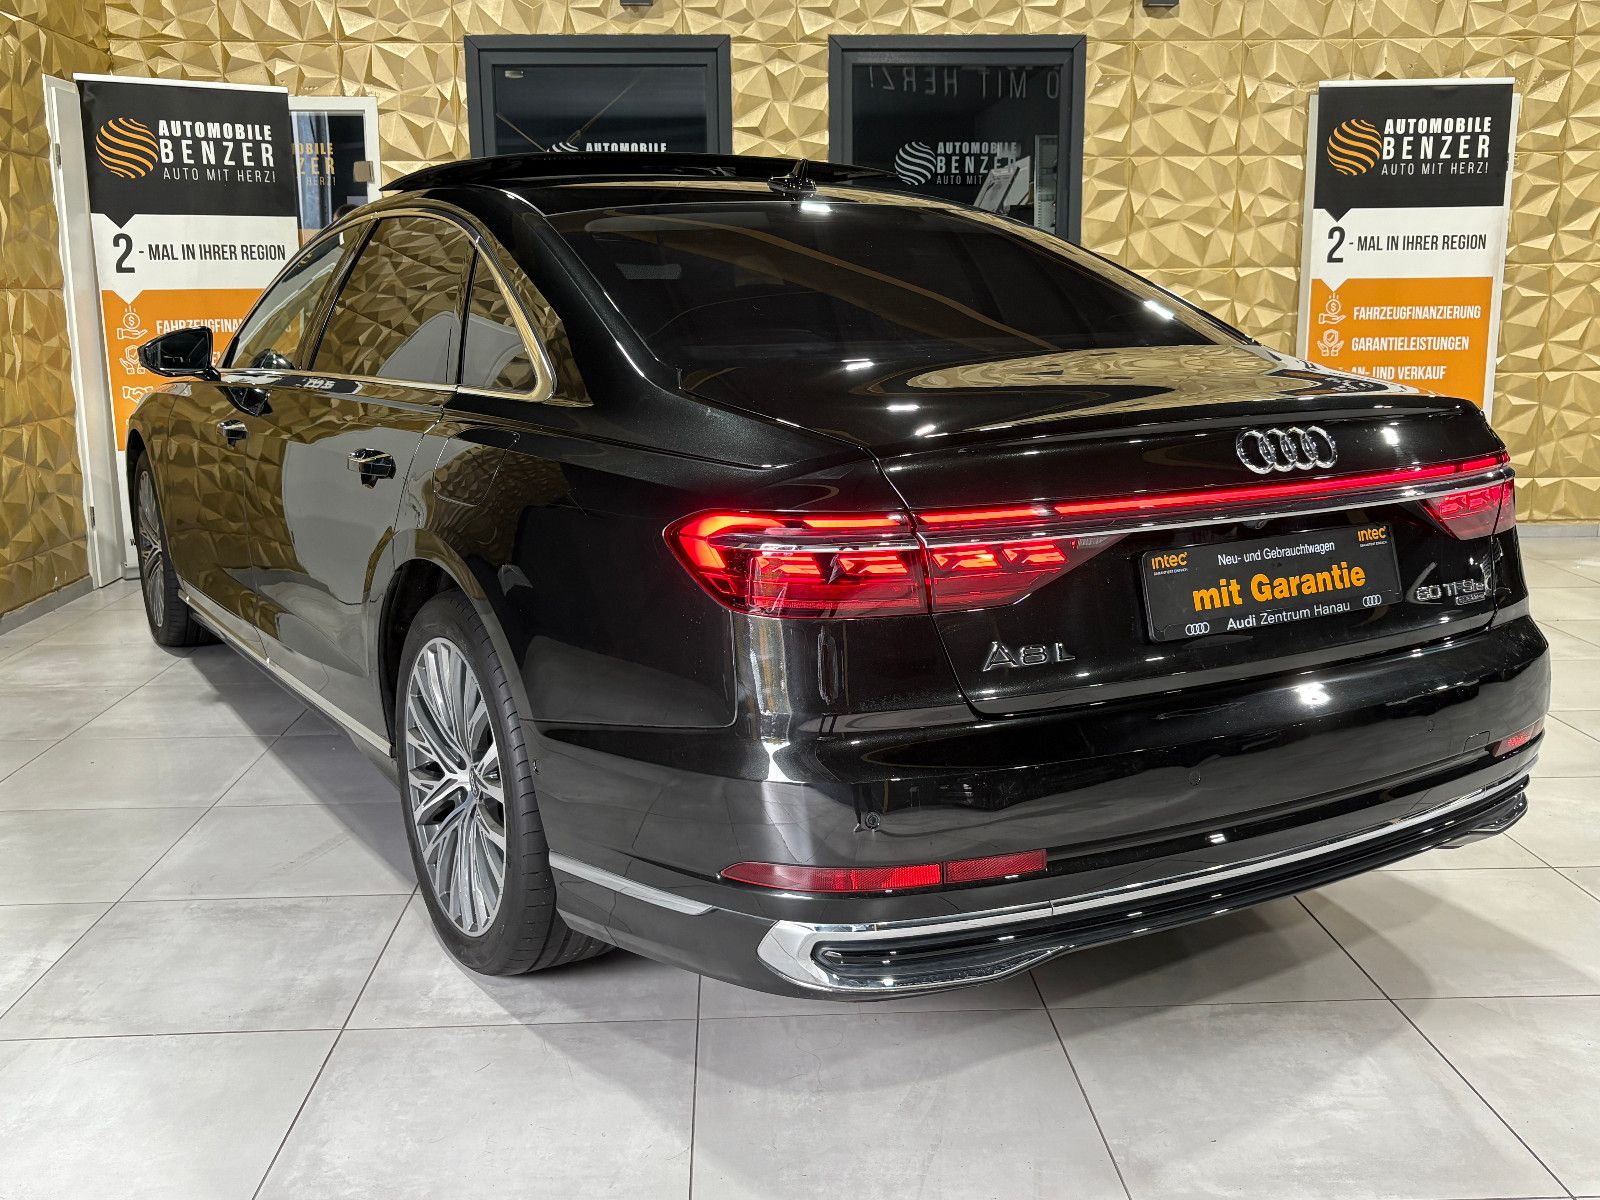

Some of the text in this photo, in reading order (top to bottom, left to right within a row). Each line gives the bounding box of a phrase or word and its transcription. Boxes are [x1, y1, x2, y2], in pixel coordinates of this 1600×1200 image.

[158, 119, 272, 141] AUTOMOBILE
[1384, 116, 1492, 135] AUTOMOBILE
[159, 138, 274, 167] BENZER
[937, 141, 1017, 154] AUTOMOBILE
[1382, 134, 1490, 160] BENZER
[163, 167, 276, 183] AUTO MIT HERZ!
[1381, 161, 1489, 176] AUTO MIT HERZ!
[936, 175, 984, 185] AUTO MIT
[112, 232, 136, 274] 2
[148, 243, 179, 261] MAL
[181, 243, 196, 261] IN
[199, 243, 238, 261] IHRER
[241, 244, 286, 261] REGION
[1326, 226, 1346, 263] 2
[1357, 235, 1383, 251] MAL
[1386, 235, 1400, 251] IN
[1402, 234, 1439, 251] IHRER
[1441, 233, 1487, 250] REGION
[1353, 305, 1481, 320] FAHRZEUGFINANZIERUNG
[1351, 336, 1469, 351] GARANTIELEISTUNGEN
[1372, 366, 1395, 380] UND
[1397, 365, 1447, 380] VERKAUF
[1217, 541, 1335, 566] Neu- und Gebrauchtwagen
[1192, 561, 1366, 612] mit Garantie
[1226, 602, 1350, 631] Audi Zentrum Hanau
